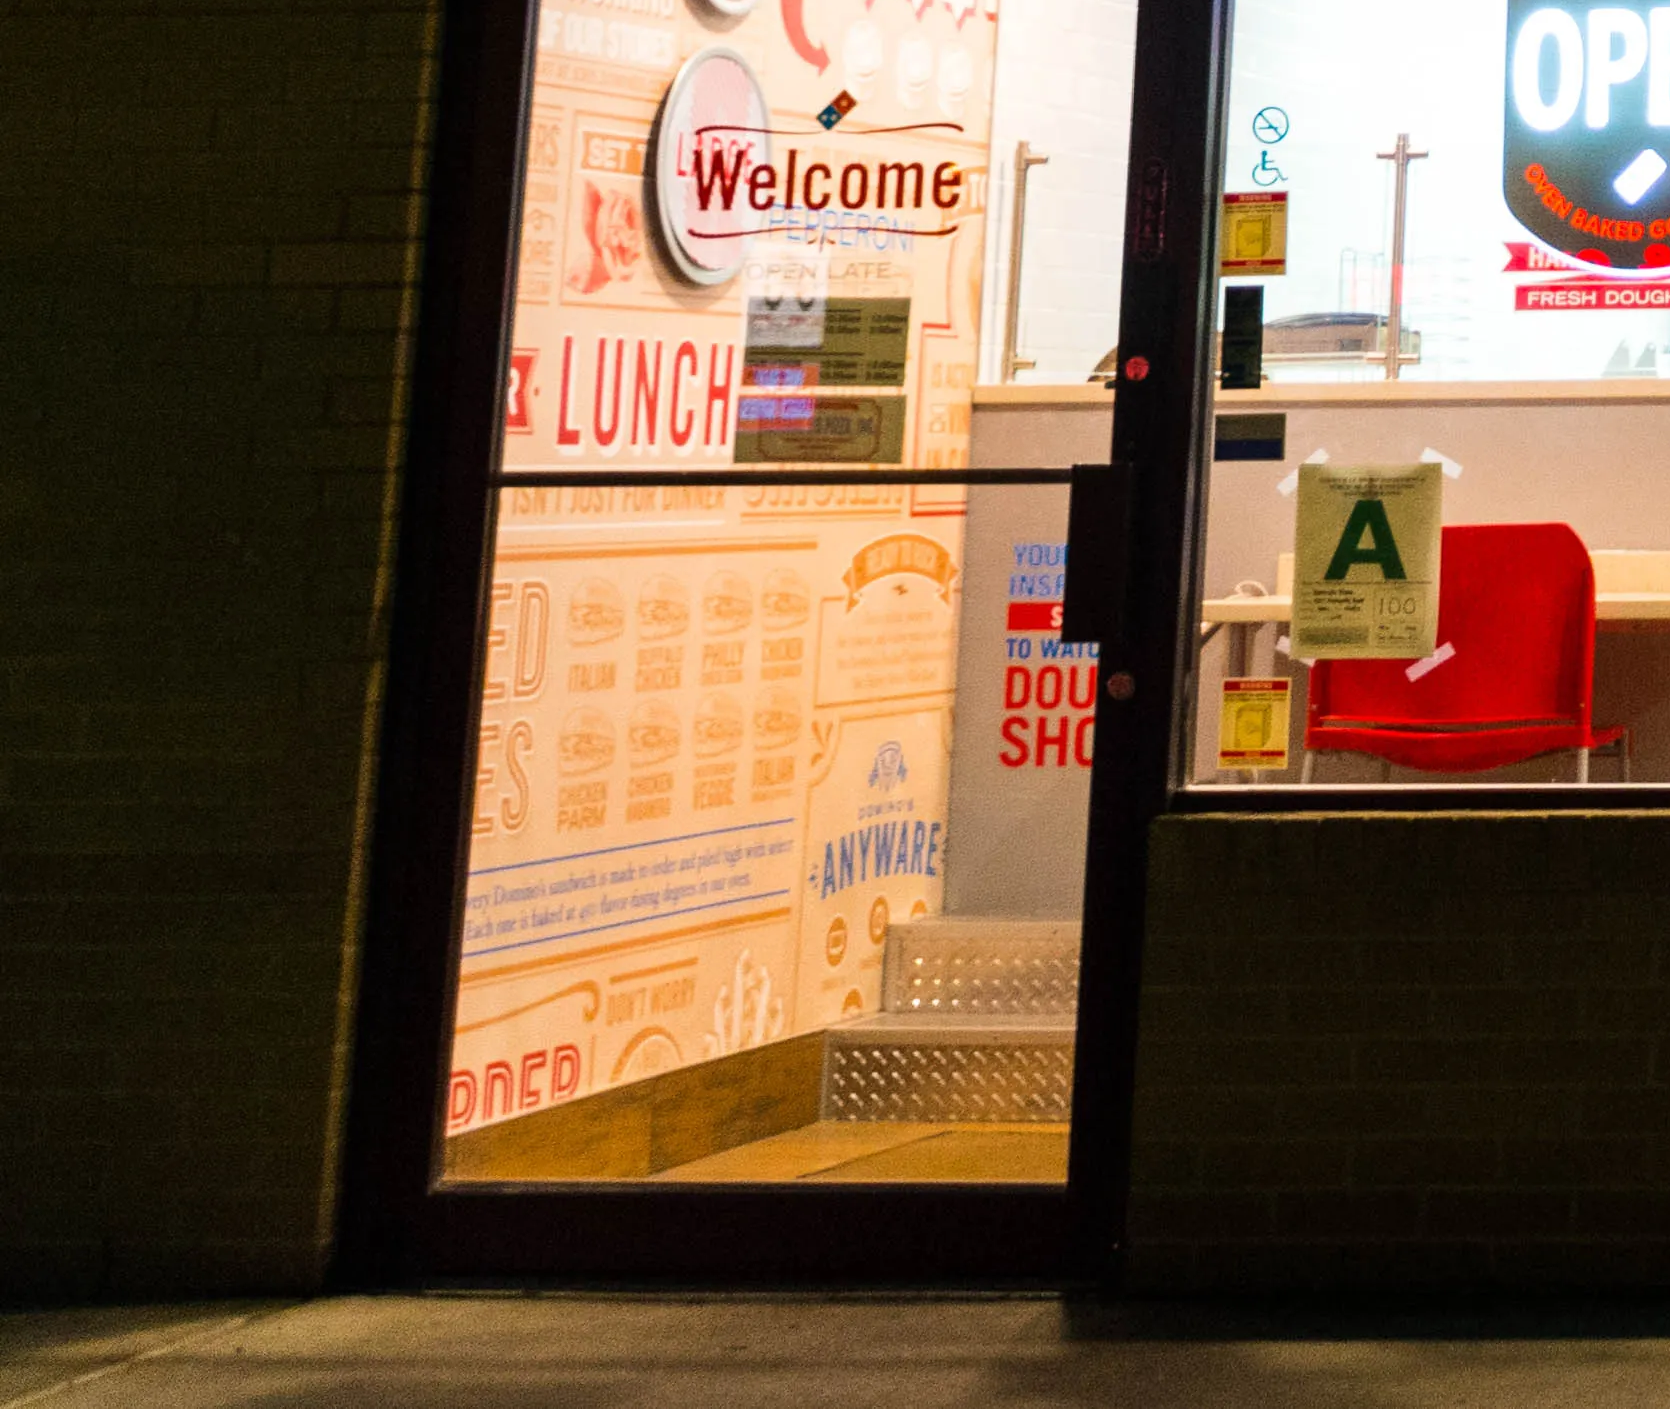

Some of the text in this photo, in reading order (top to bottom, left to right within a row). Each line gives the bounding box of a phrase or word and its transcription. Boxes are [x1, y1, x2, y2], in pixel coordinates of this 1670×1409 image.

[586, 136, 632, 171] SET
[692, 148, 962, 212] Welcome
[1523, 161, 1575, 221] OVEN
[1569, 206, 1646, 243] BAKED
[1526, 290, 1597, 307] FRESH
[556, 335, 736, 449] LUNCH
[1323, 499, 1408, 580] A
[1378, 597, 1417, 615] 100
[1005, 638, 1033, 660] TO
[819, 819, 942, 901] ANYWARE
